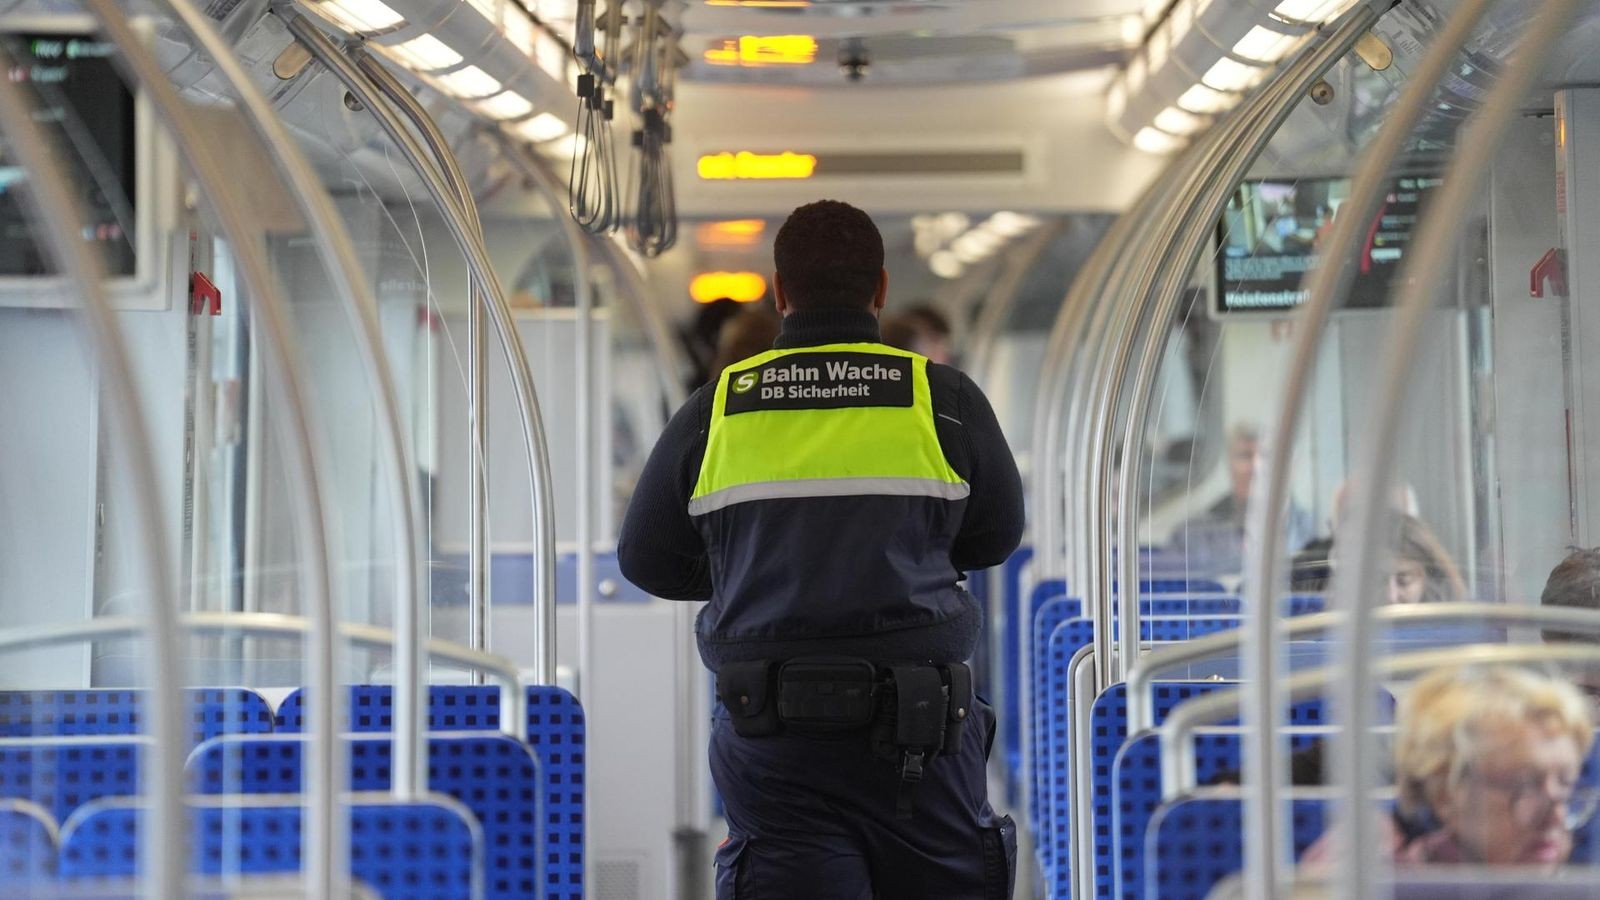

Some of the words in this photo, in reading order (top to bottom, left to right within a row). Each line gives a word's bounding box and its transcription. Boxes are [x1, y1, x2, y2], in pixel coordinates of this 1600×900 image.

[735, 373, 755, 393] S
[762, 363, 819, 384] Bahn
[825, 361, 902, 381] Wache
[761, 386, 785, 399] DB
[788, 383, 870, 399] Sicherheit
